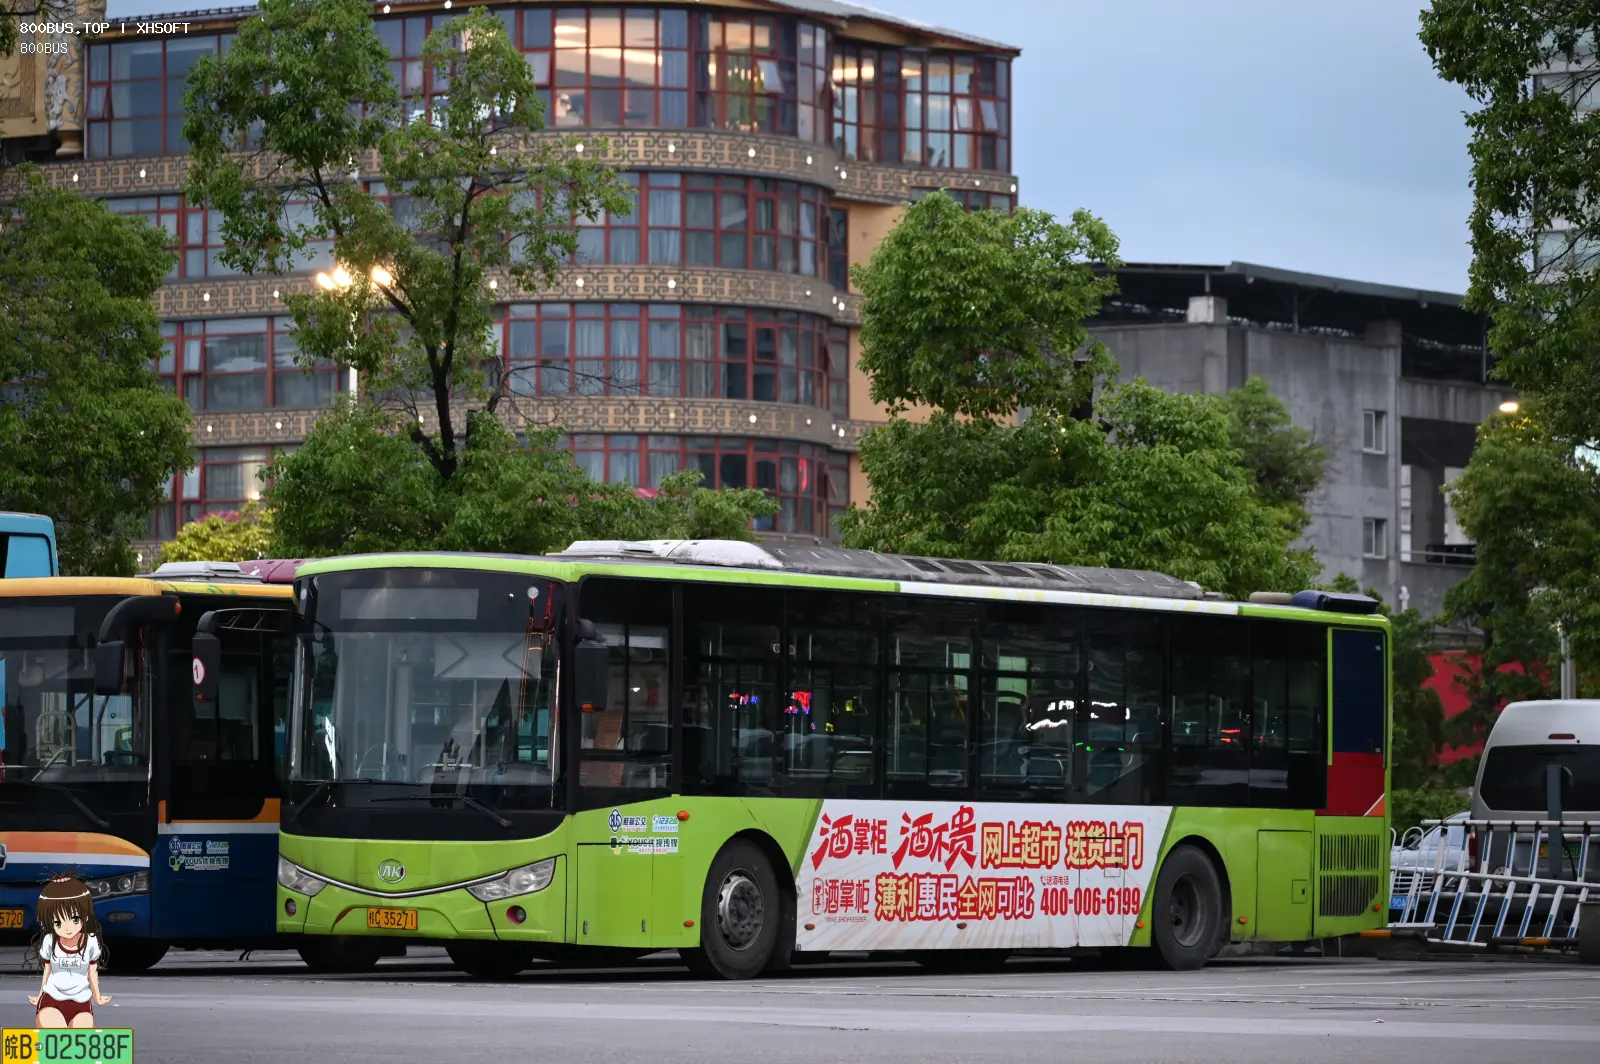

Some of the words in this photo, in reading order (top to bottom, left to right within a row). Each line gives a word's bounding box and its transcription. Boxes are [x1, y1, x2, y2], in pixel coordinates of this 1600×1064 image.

[811, 812, 888, 872] 酒掌柜
[891, 804, 978, 873] 酒不贵
[981, 820, 1062, 870] 网上超市
[1065, 820, 1144, 870] 送货上门
[824, 879, 871, 914] 酒掌柜
[875, 871, 1036, 922] 薄利惠民全网可比
[1040, 887, 1141, 916] 400-006-6199
